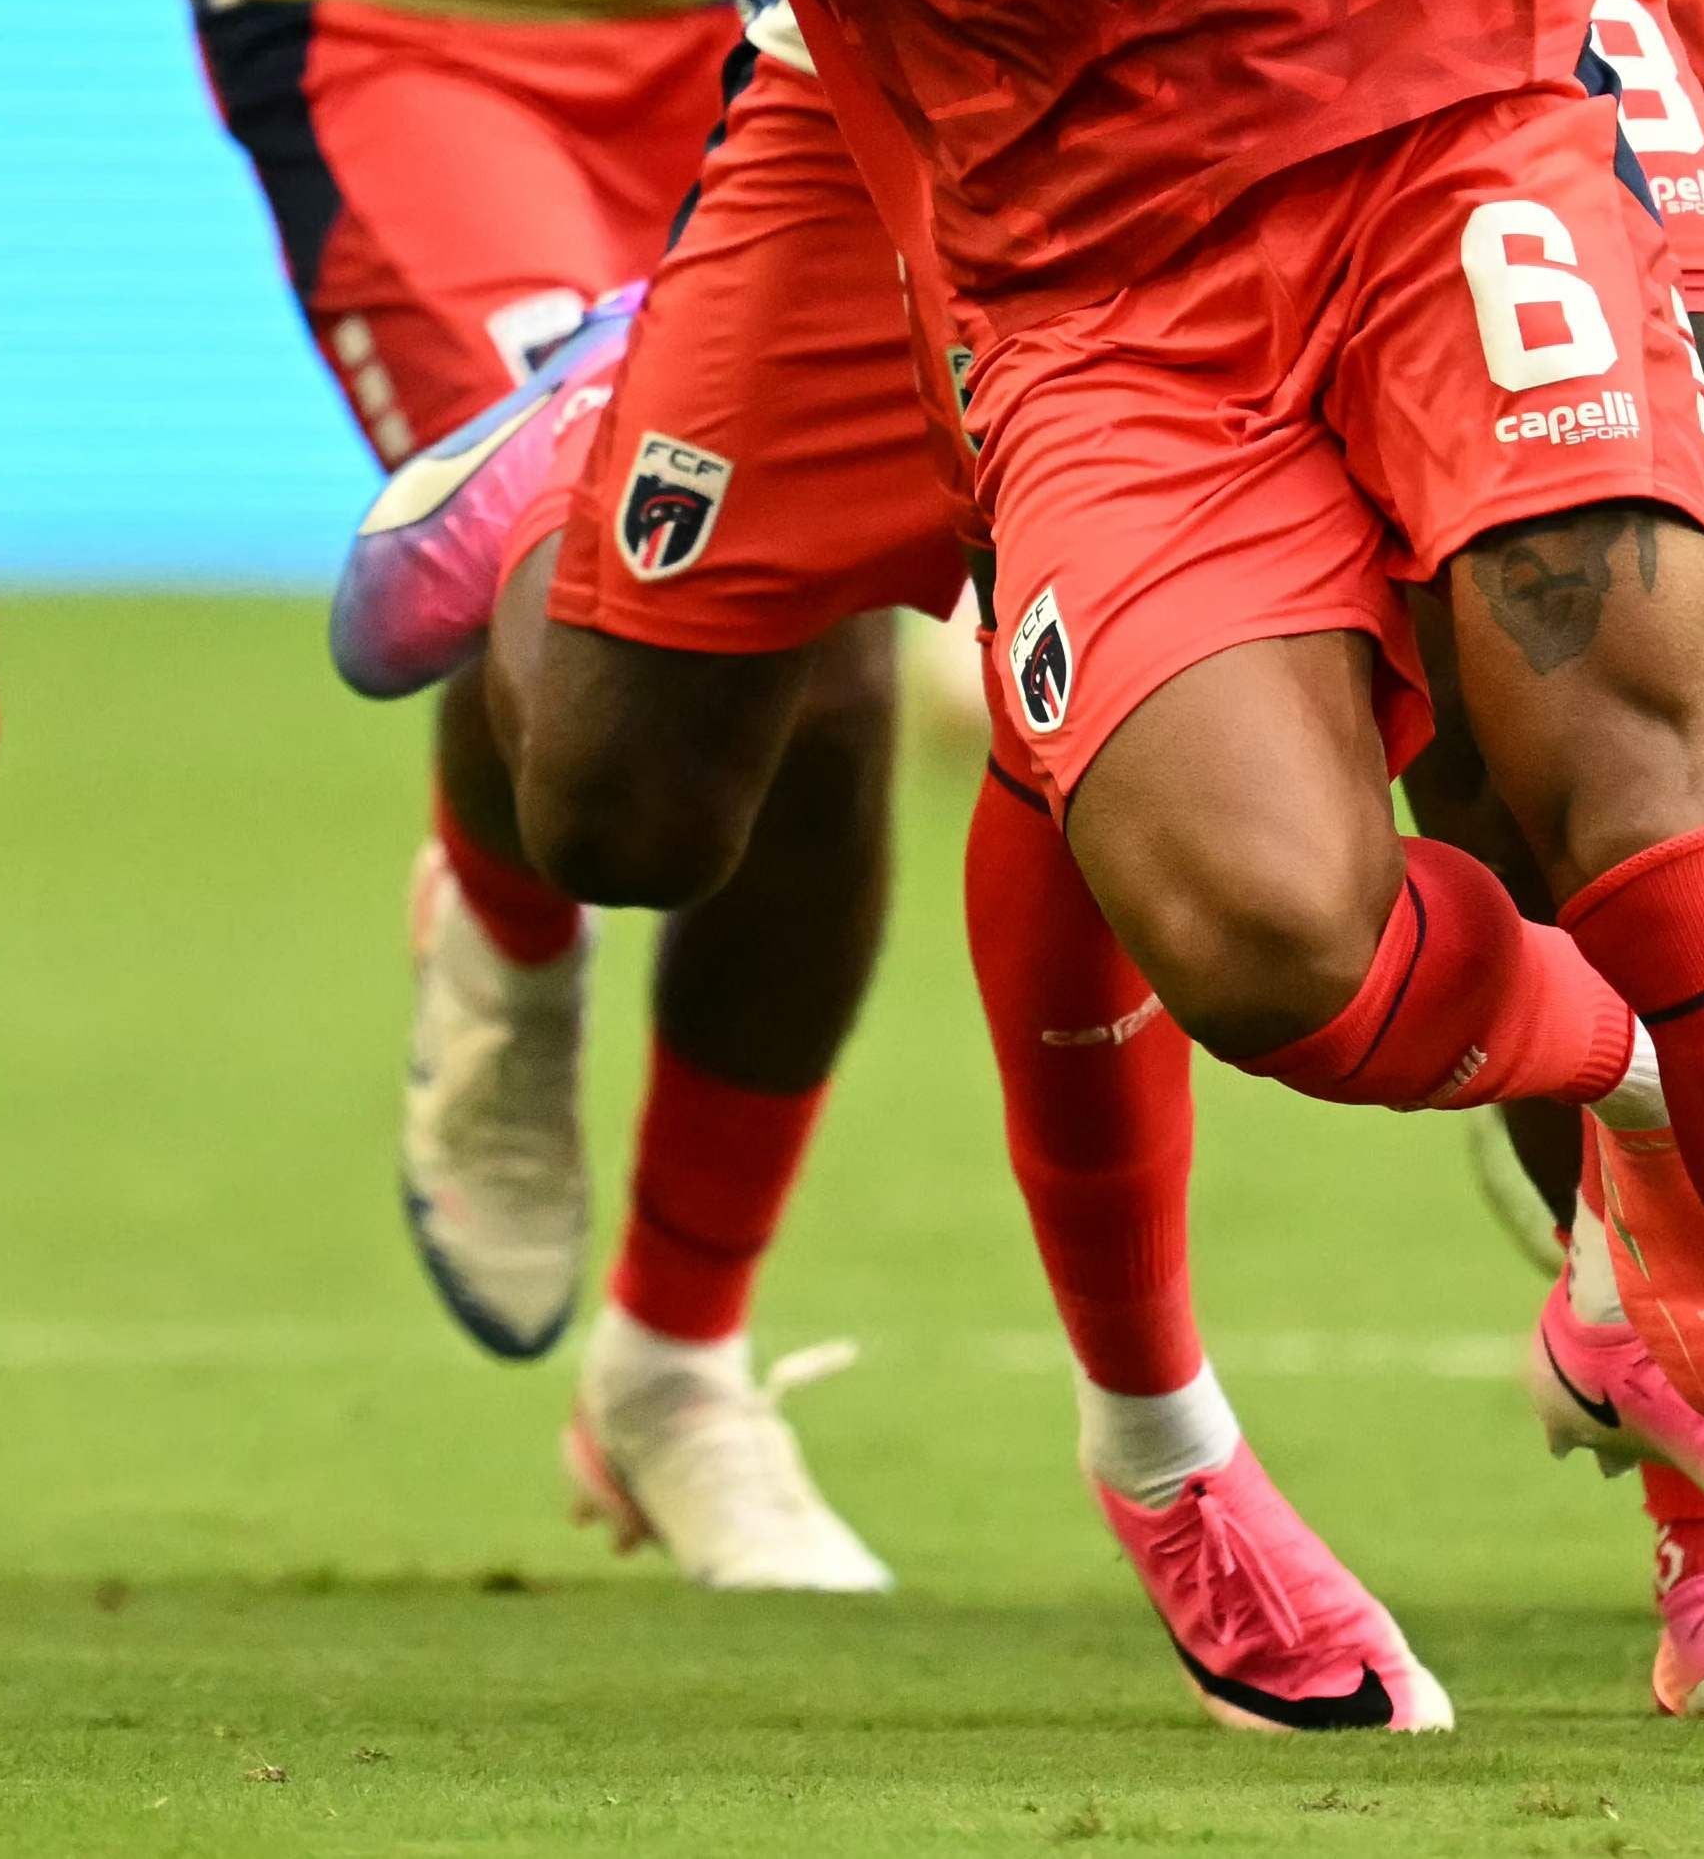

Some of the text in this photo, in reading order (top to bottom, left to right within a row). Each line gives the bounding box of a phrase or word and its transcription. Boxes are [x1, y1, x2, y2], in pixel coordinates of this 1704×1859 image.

[1460, 199, 1619, 393] 6
[1495, 390, 1640, 446] capelli
[1564, 426, 1641, 446] SPORT
[643, 440, 724, 476] FCF
[1013, 594, 1049, 664] FCF
